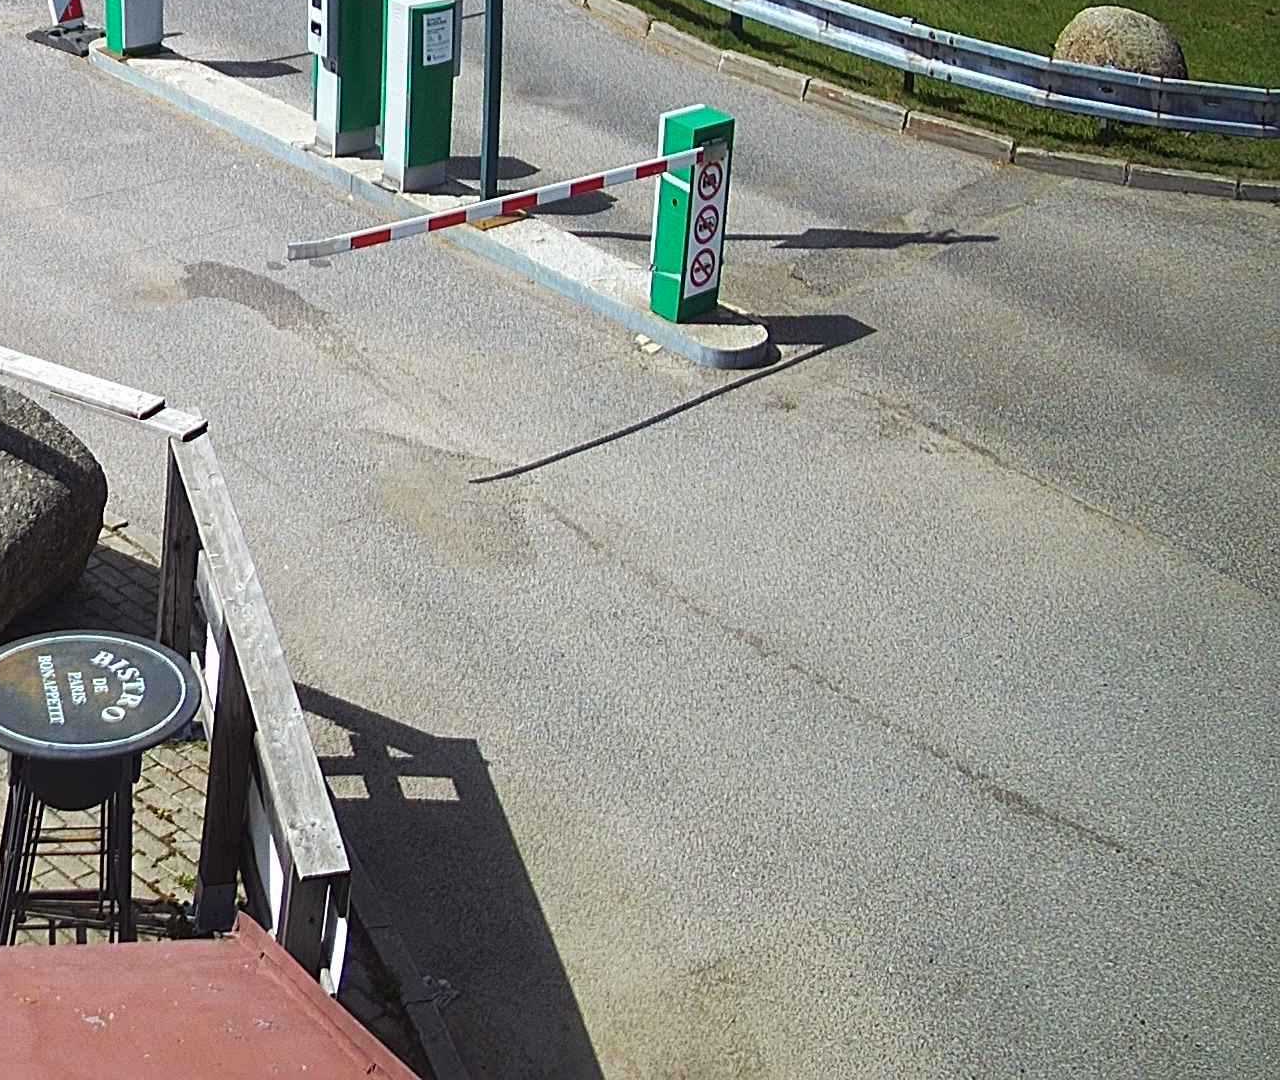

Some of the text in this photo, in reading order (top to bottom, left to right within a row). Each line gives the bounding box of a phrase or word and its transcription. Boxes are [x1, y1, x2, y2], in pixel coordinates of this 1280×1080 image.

[38, 655, 57, 679] BON
[68, 671, 87, 706] PARIS
[90, 650, 146, 723] BISTRO
[93, 677, 109, 695] DE
